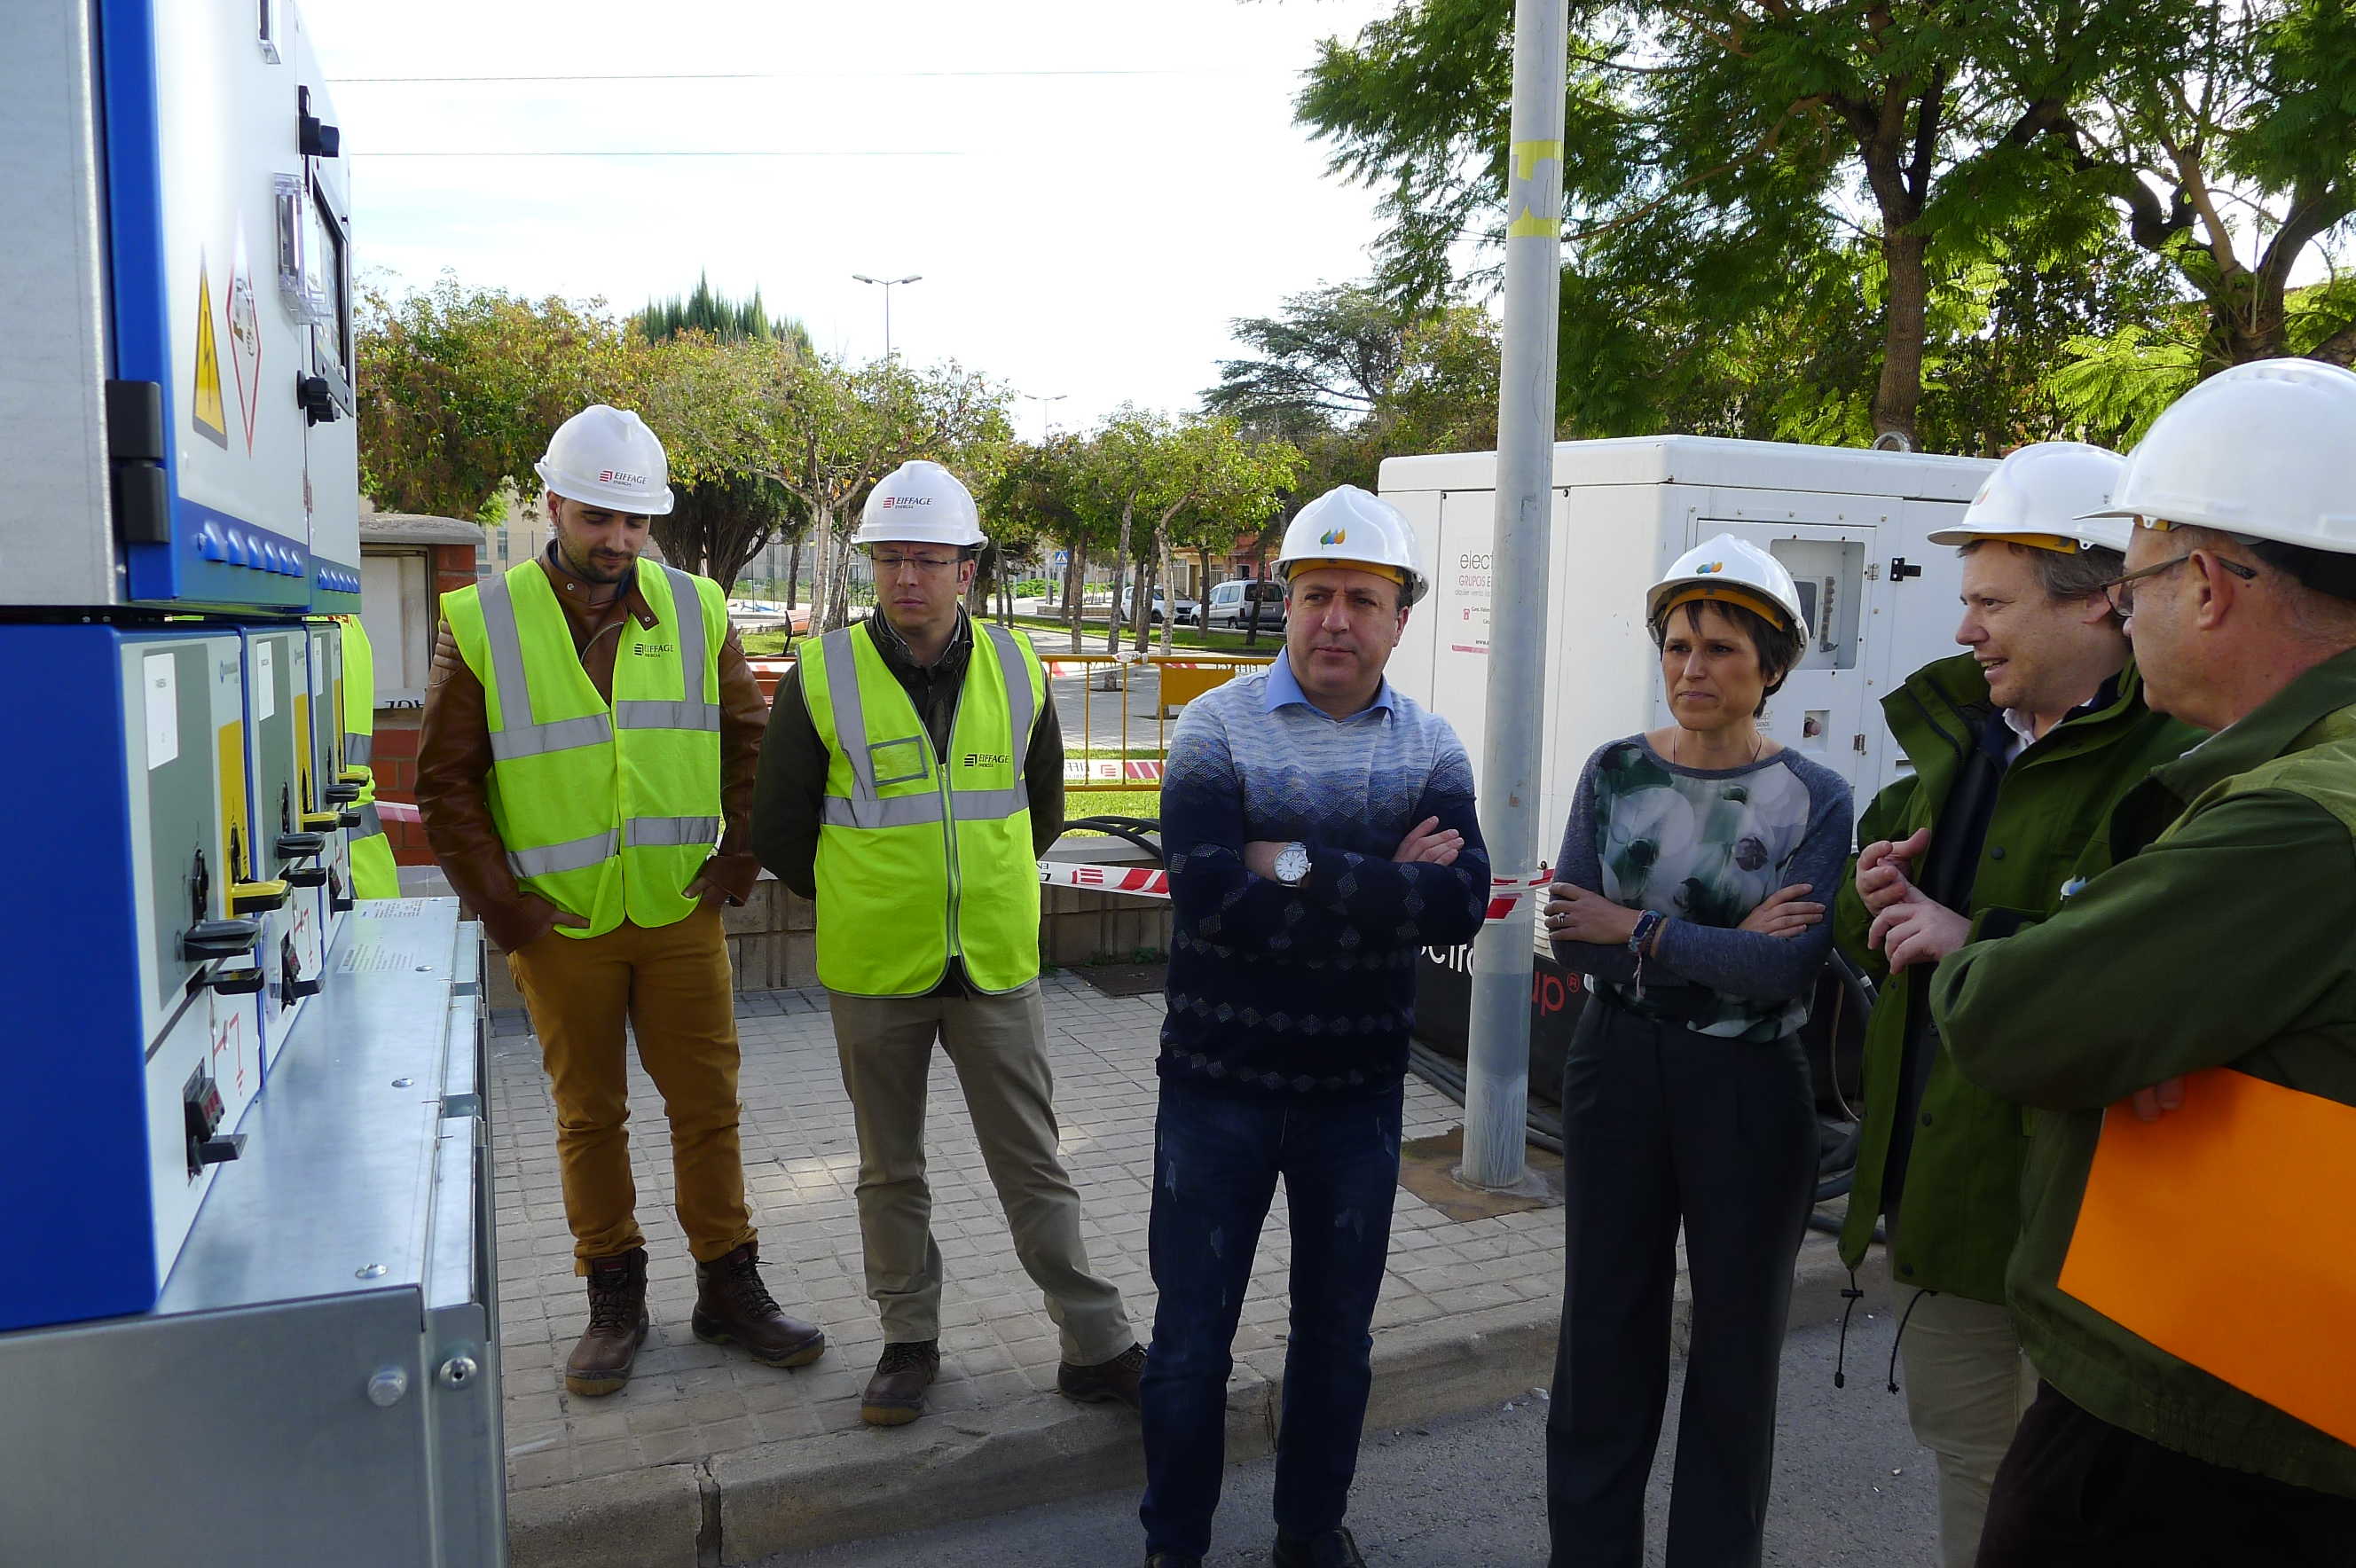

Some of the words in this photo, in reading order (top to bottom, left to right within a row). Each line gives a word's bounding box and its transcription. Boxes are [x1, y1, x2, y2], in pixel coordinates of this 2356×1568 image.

[614, 472, 648, 485] EIFFAGE
[896, 497, 933, 506] EIFFAGE
[1460, 550, 1491, 570] elec
[1458, 575, 1486, 587] GRUPOS
[978, 753, 1009, 764] EIFFAGE
